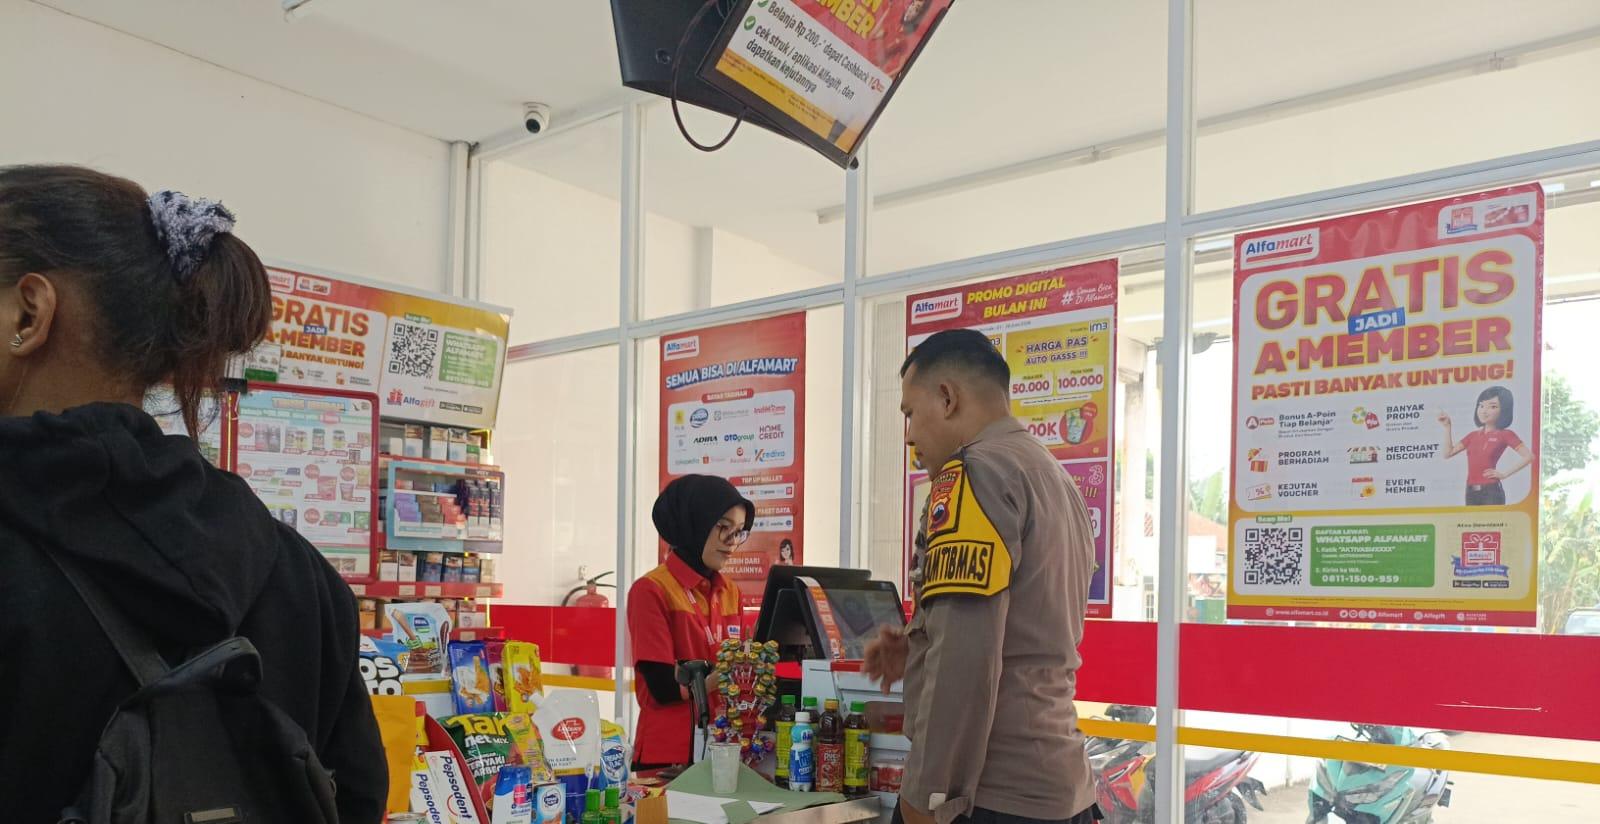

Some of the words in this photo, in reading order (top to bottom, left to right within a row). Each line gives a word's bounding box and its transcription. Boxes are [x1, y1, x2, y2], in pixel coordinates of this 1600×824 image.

[768, 1, 797, 30] Belanja
[796, 20, 807, 37] Rp
[823, 43, 844, 64] dapat
[841, 56, 870, 83] Cashback
[746, 39, 781, 69] dapatkan
[779, 61, 817, 93] kejutannya
[755, 25, 770, 41] cek
[769, 34, 791, 57] struk
[791, 51, 822, 77] aplikasi
[841, 85, 855, 101] dan
[1245, 233, 1313, 255] Alfamart
[967, 285, 1013, 305] PROMO
[1015, 276, 1066, 296] DIGITAL
[1255, 250, 1515, 331] GRATIS
[915, 297, 959, 313] Alfamart
[983, 301, 1027, 319] BULAN
[1029, 297, 1048, 311] INI
[271, 296, 370, 337] GRATIS
[1354, 312, 1398, 332] JADI
[305, 326, 326, 334] JADI
[666, 340, 697, 353] Alfamart
[1026, 341, 1062, 354] HARGA
[1067, 337, 1088, 347] PAS
[286, 351, 324, 362] BANYAK
[325, 356, 365, 370] UNTUNG!
[1025, 355, 1048, 366] AUTO
[1050, 352, 1077, 362] GASSS
[666, 371, 700, 389] SEMUA
[701, 365, 725, 381] BISA
[726, 363, 738, 376] DI
[738, 358, 798, 374] ALFAMART
[1251, 380, 1310, 401] PASTI
[1313, 373, 1403, 396] BANYAK
[1406, 359, 1515, 387] UNTUNG!
[1012, 380, 1050, 394] 50.000
[1058, 374, 1103, 389] 100.000
[404, 396, 436, 408] Alfagift
[1386, 404, 1425, 413] BANYAK
[1307, 411, 1336, 419] A-Poin
[1386, 411, 1420, 420] PROMO
[759, 424, 782, 433] HOME
[1027, 422, 1057, 438] 00K
[1279, 421, 1296, 429] Tiap
[759, 431, 785, 441] CREDIT
[1278, 450, 1321, 458] PROGRAM
[1386, 444, 1440, 453] MERCHANT
[1278, 457, 1329, 466] BERHADIAH
[1386, 452, 1435, 461] DISCOUNT
[1278, 482, 1318, 490] KEJUTAN
[1385, 486, 1426, 494] MEMBER
[1278, 490, 1319, 498] VOUCHER
[1315, 536, 1371, 544] WHATSAPP
[1373, 534, 1428, 543] ALFAMART
[745, 557, 760, 565] DARI
[465, 734, 493, 748] net
[440, 755, 473, 819] Pepsodent
